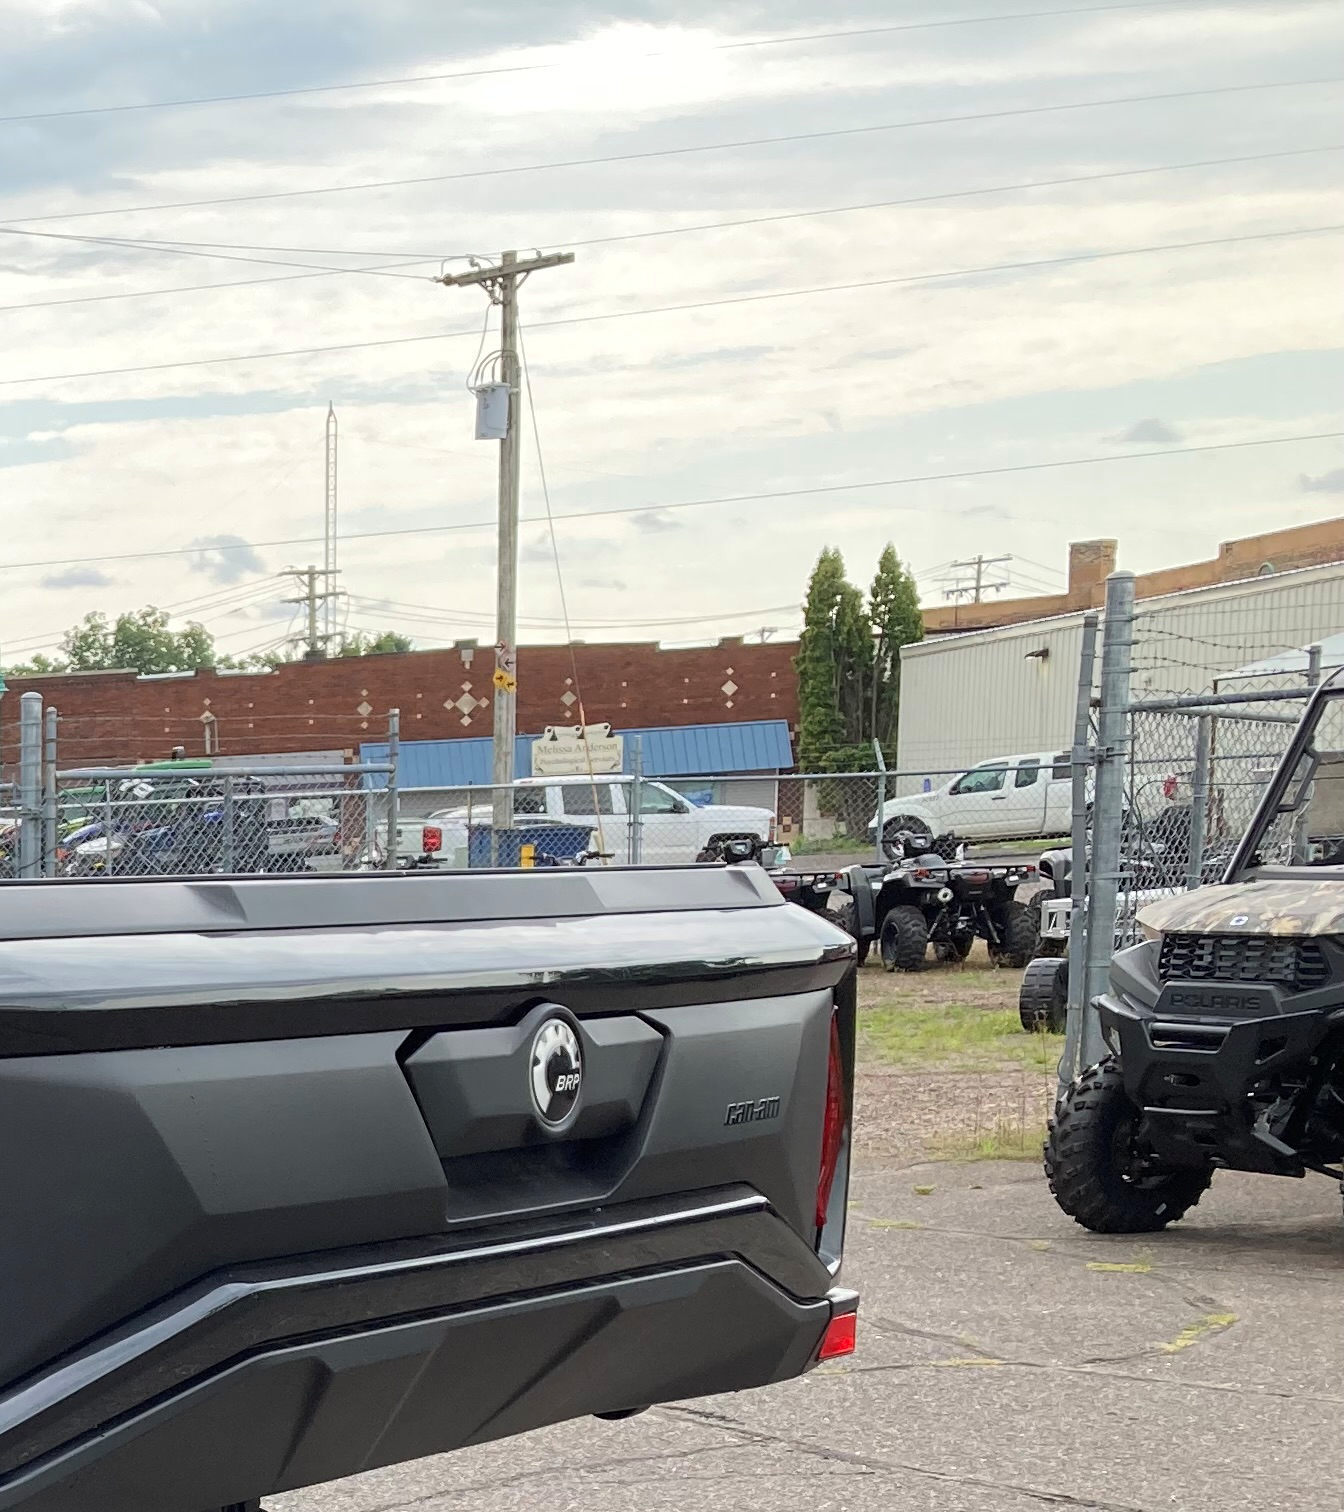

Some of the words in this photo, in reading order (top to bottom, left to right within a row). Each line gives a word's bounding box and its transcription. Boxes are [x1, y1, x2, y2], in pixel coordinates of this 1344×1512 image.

[537, 744, 573, 755] Melissa
[575, 742, 618, 754] Anderson
[1170, 993, 1261, 1010] POLARIS
[555, 1073, 580, 1092] BRP
